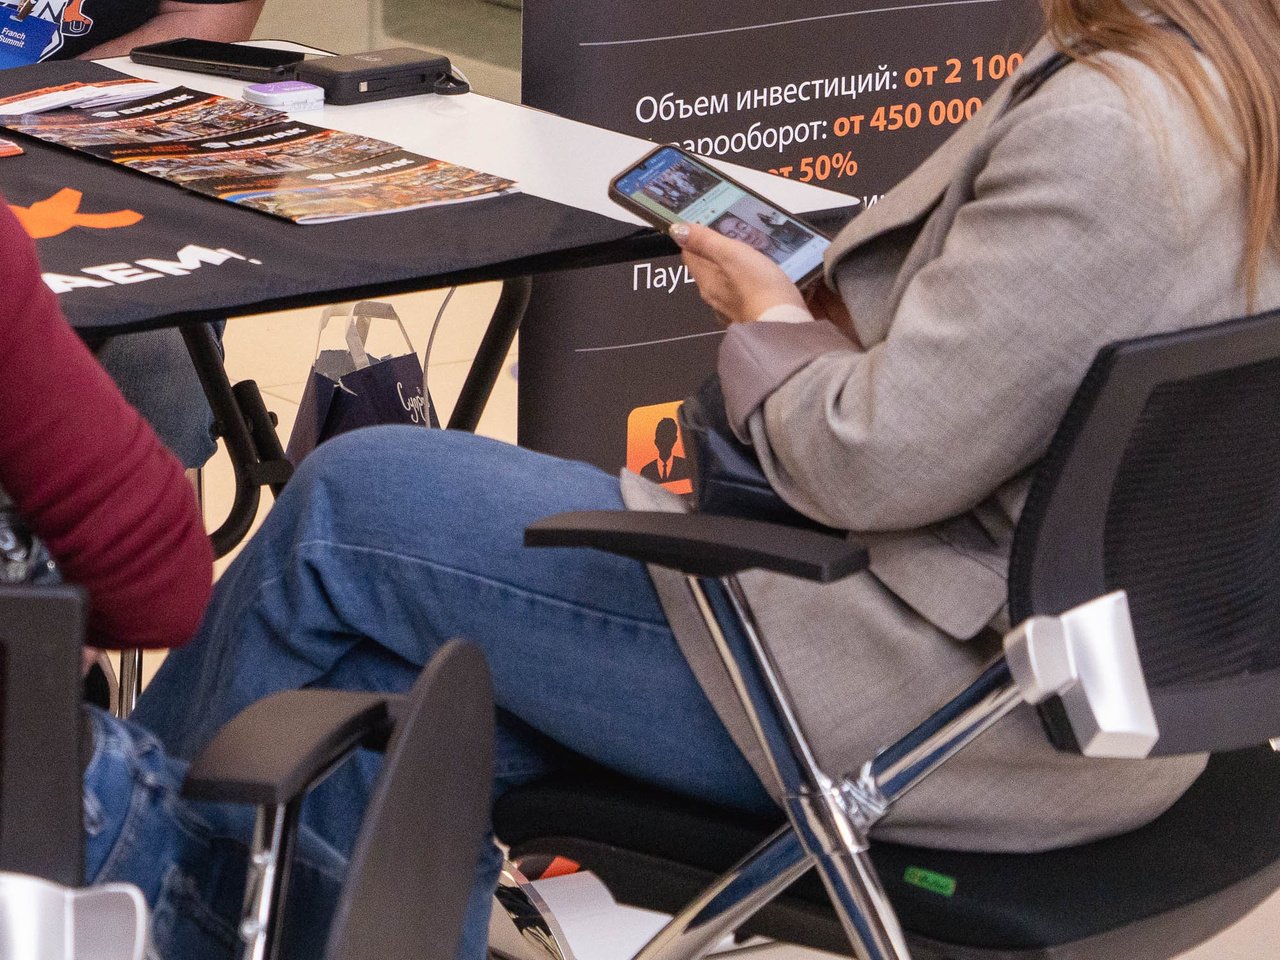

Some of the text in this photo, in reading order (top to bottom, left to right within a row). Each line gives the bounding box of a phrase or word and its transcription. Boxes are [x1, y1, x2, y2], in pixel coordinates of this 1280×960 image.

[1, 27, 26, 40] Franch
[635, 92, 729, 124] Объем
[736, 65, 898, 111] инвестиций:
[904, 66, 938, 88] от
[944, 58, 962, 84] 2
[669, 119, 827, 157] арооборот:
[832, 113, 864, 137] от
[869, 102, 922, 132] 450
[800, 151, 858, 182] 50%
